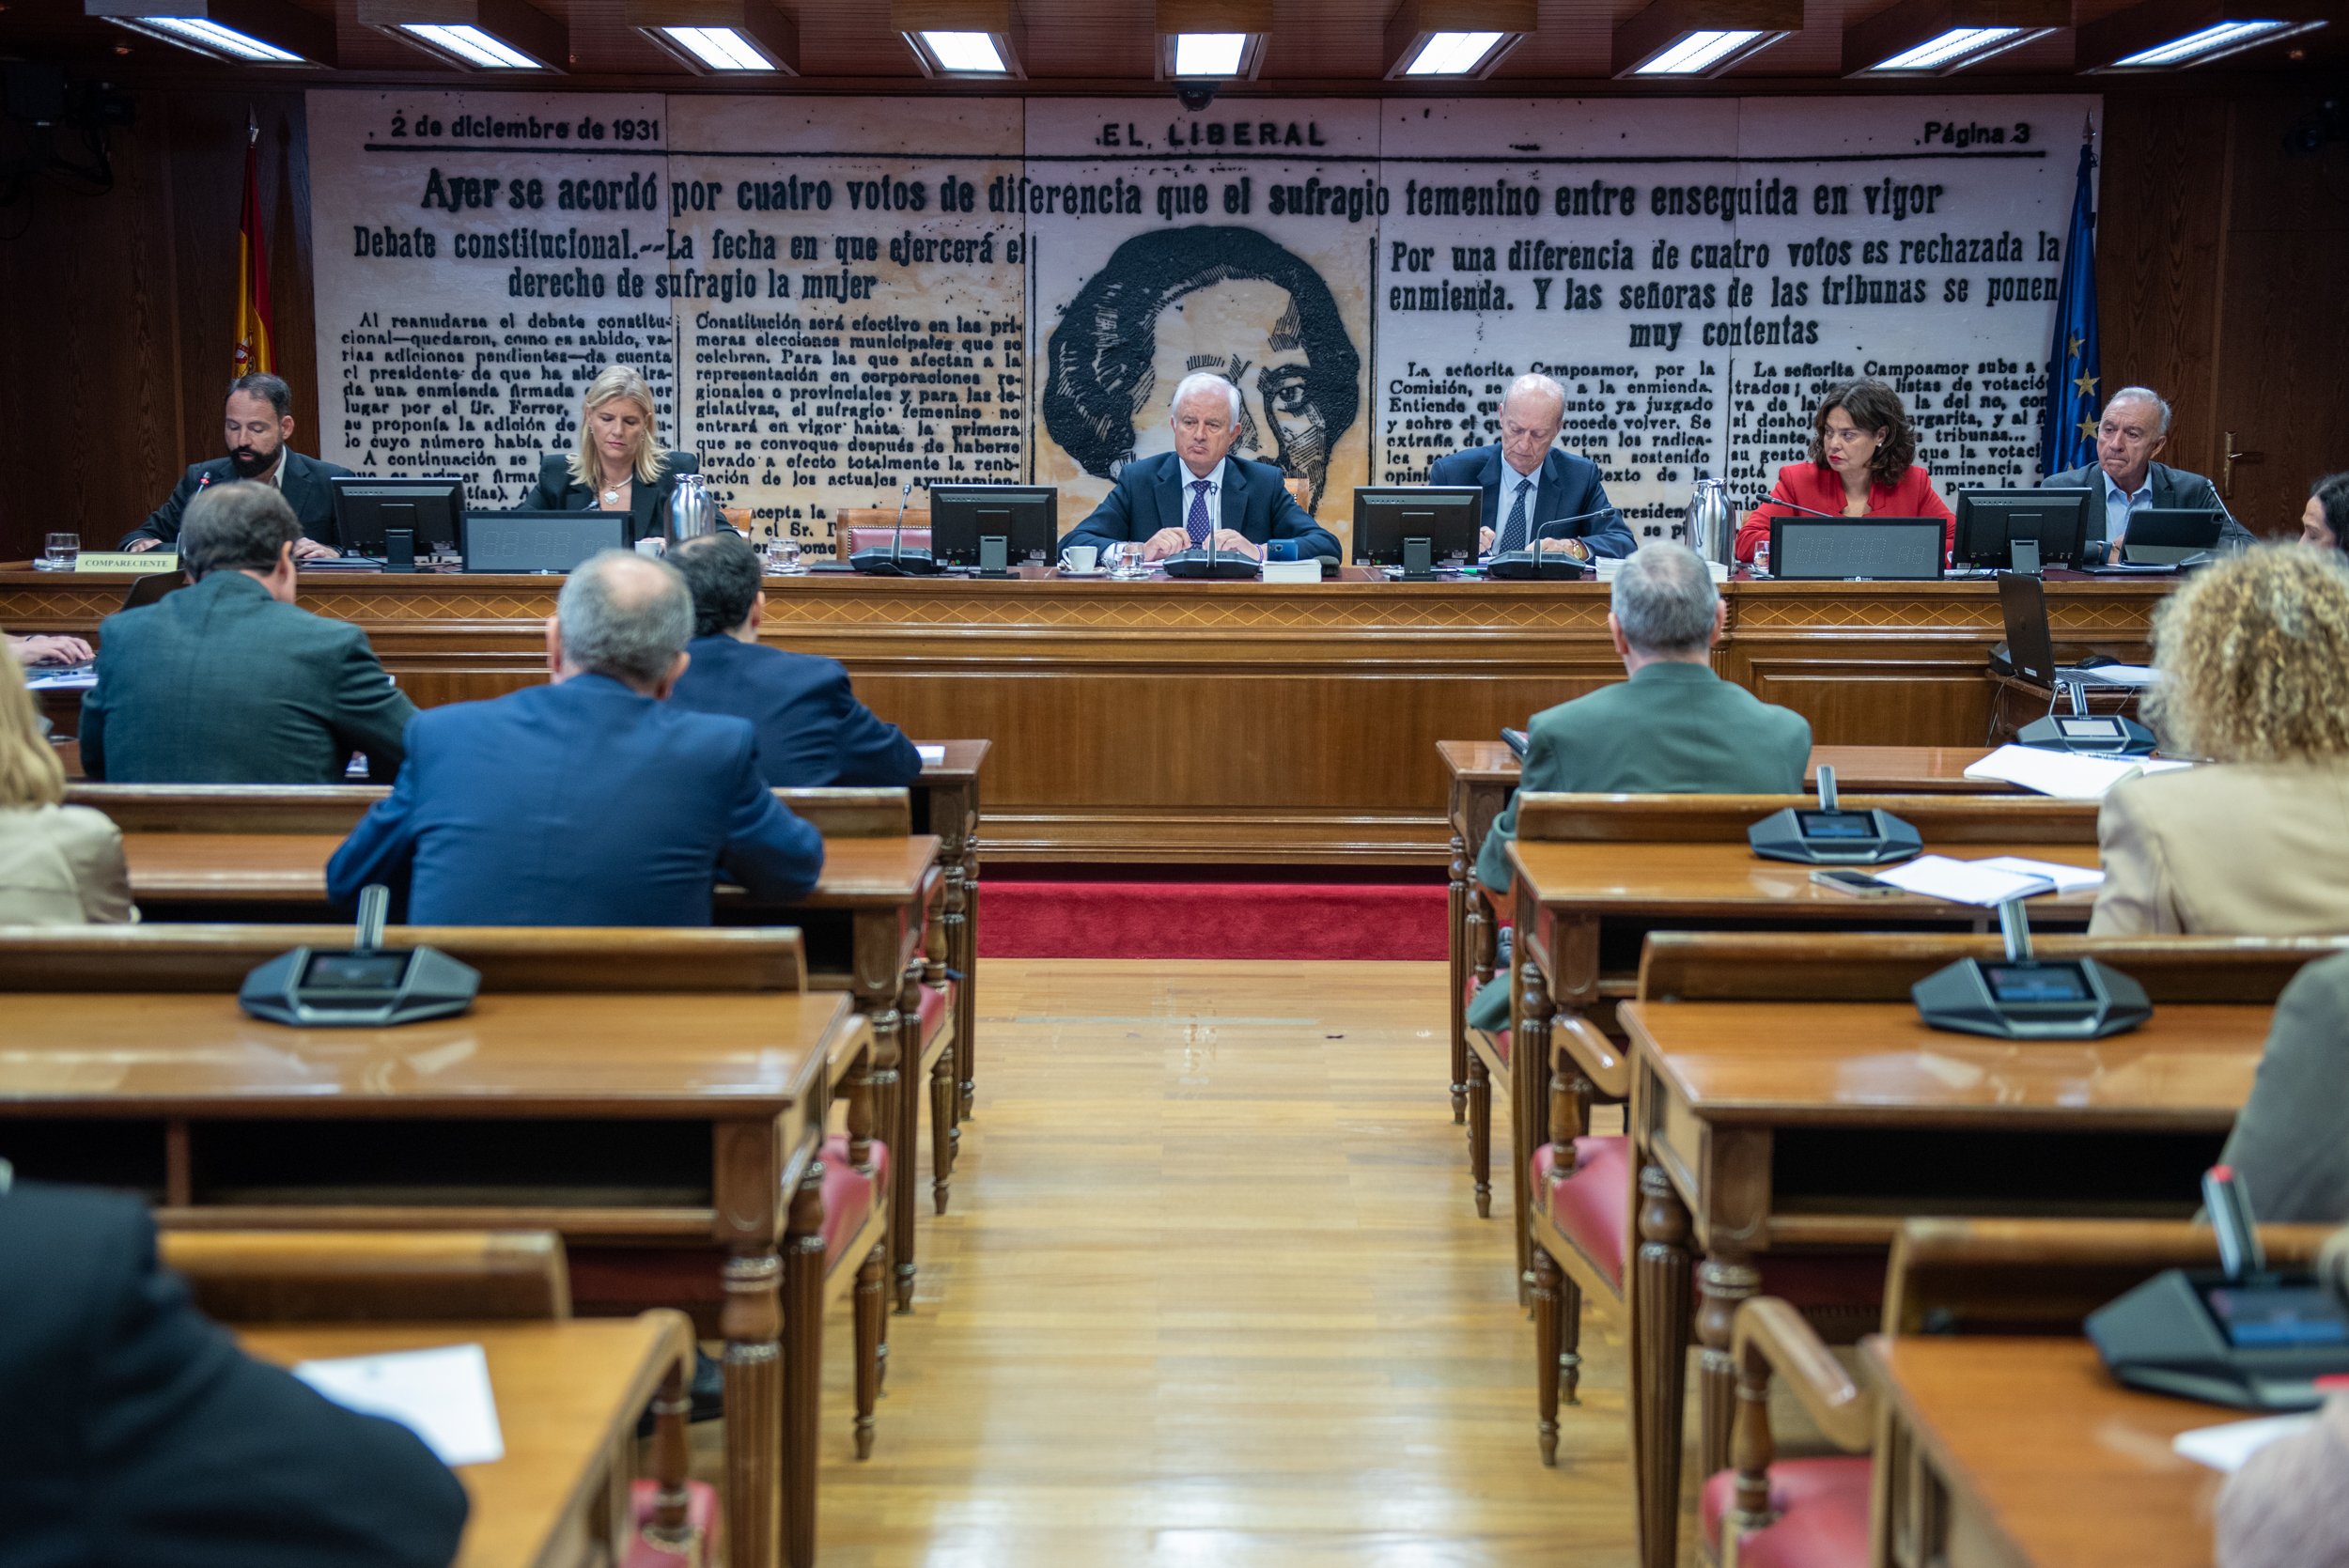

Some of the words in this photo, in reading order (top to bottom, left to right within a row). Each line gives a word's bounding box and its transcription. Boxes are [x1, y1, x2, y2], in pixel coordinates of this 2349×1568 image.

[392, 115, 405, 139] 2
[415, 116, 442, 139] de
[452, 116, 568, 140] diciembre
[577, 118, 604, 141] de
[613, 120, 659, 142] 1931
[1168, 122, 1325, 147] LIBERAL
[1924, 122, 2003, 147] Página
[2013, 123, 2030, 143] 3
[422, 168, 502, 212] Ayer
[510, 181, 542, 210] se
[559, 173, 657, 210] acordó
[673, 181, 721, 215] por
[737, 175, 832, 210] cuatro
[848, 176, 925, 210] votos
[941, 175, 974, 212] de
[988, 177, 1142, 214] diferencia
[1158, 182, 1207, 220] que
[1223, 177, 1250, 214] el
[1269, 178, 1389, 222] sufragio
[1408, 179, 1540, 217] femenino
[1556, 181, 1635, 217] entre
[1652, 179, 1798, 221] enseguida
[1814, 184, 1848, 215] en
[1864, 179, 1943, 223] vigor
[355, 227, 436, 258] Debate
[712, 229, 775, 261] fecha
[791, 239, 817, 261] en
[836, 236, 878, 265] que
[890, 231, 994, 267] ejercerá
[1006, 230, 1027, 264] el
[1392, 242, 1434, 272] Por
[1453, 246, 1496, 272] una
[1508, 239, 1633, 272] diferencia
[1653, 239, 1678, 271] de
[1692, 241, 1768, 270] cuatro
[1787, 238, 1851, 267] votos
[1862, 239, 1889, 265] es
[1899, 231, 2022, 264] rechazada
[2038, 233, 2060, 262] la
[508, 267, 603, 299] derecho
[618, 268, 643, 298] de
[656, 270, 756, 302] sufragio
[769, 269, 790, 298] la
[802, 272, 879, 303] mujer
[1390, 280, 1513, 312] enmienda.
[1535, 278, 1551, 309] Y
[1564, 278, 1601, 311] las
[1619, 278, 1715, 309] señoras
[1728, 278, 1753, 308] de
[1772, 277, 1807, 308] las
[1822, 275, 1925, 306] tribunas
[1943, 278, 1968, 304] se
[1986, 275, 2058, 306] ponen
[360, 312, 378, 328] Al
[392, 313, 488, 328] reanudarse
[500, 313, 515, 328] el
[528, 313, 584, 328] debate
[696, 314, 799, 330] Constitución
[809, 315, 844, 331] será
[852, 315, 920, 333] efectivo
[957, 316, 981, 333] las
[505, 334, 547, 346] como
[696, 334, 746, 347] meras
[849, 334, 953, 351] municipales
[962, 338, 997, 351] que
[1629, 322, 1680, 350] muy
[1703, 317, 1818, 346] contentas
[616, 348, 672, 363] cuenta
[782, 349, 822, 365] Para
[832, 349, 856, 365] las
[868, 351, 898, 367] que
[910, 351, 972, 367] afectan
[1005, 351, 1021, 367] la
[344, 365, 358, 380] el
[500, 368, 531, 383] que
[696, 365, 818, 382] representación
[862, 371, 980, 388] corporaciones
[1408, 363, 1430, 377] La
[1656, 365, 1684, 380] por
[1700, 361, 1715, 376] la
[1754, 362, 1780, 378] La
[1863, 361, 1969, 379] Campoamor
[1978, 359, 2016, 374] sube
[417, 382, 499, 397] enmienda
[510, 382, 574, 397] firmada
[696, 382, 765, 400] gionales
[790, 384, 892, 402] provinciales
[920, 390, 957, 405] para
[967, 388, 990, 403] las
[1390, 380, 1472, 396] Comisión,
[1599, 380, 1615, 394] la
[346, 401, 389, 416] lugar
[402, 403, 430, 417] por
[443, 400, 457, 414] el
[1390, 396, 1465, 412] Entiende
[1944, 395, 1969, 410] del
[903, 405, 981, 419] femenino
[1000, 409, 1020, 419] no
[373, 417, 449, 434] proponía
[459, 417, 474, 431] la
[485, 417, 545, 431] adición
[696, 419, 756, 433] entrará
[918, 421, 934, 436] la
[952, 422, 1020, 437] primera
[1406, 415, 1453, 430] sobre
[1690, 414, 1712, 429] Se
[371, 435, 411, 452] cuyo
[421, 434, 485, 449] número
[494, 434, 543, 449] había
[696, 438, 725, 452] que
[761, 440, 838, 453] convoque
[848, 437, 913, 455] después
[1561, 434, 1608, 447] voten
[1619, 432, 1641, 447] los
[364, 452, 377, 466] A
[387, 452, 496, 466] continuación
[697, 453, 754, 468] llevado
[848, 455, 940, 471] totalmente
[949, 455, 964, 471] la
[1631, 449, 1709, 463] sostenido
[1919, 449, 1950, 462] que
[793, 471, 816, 488] los
[1731, 464, 1766, 478] está
[810, 504, 826, 520] la
